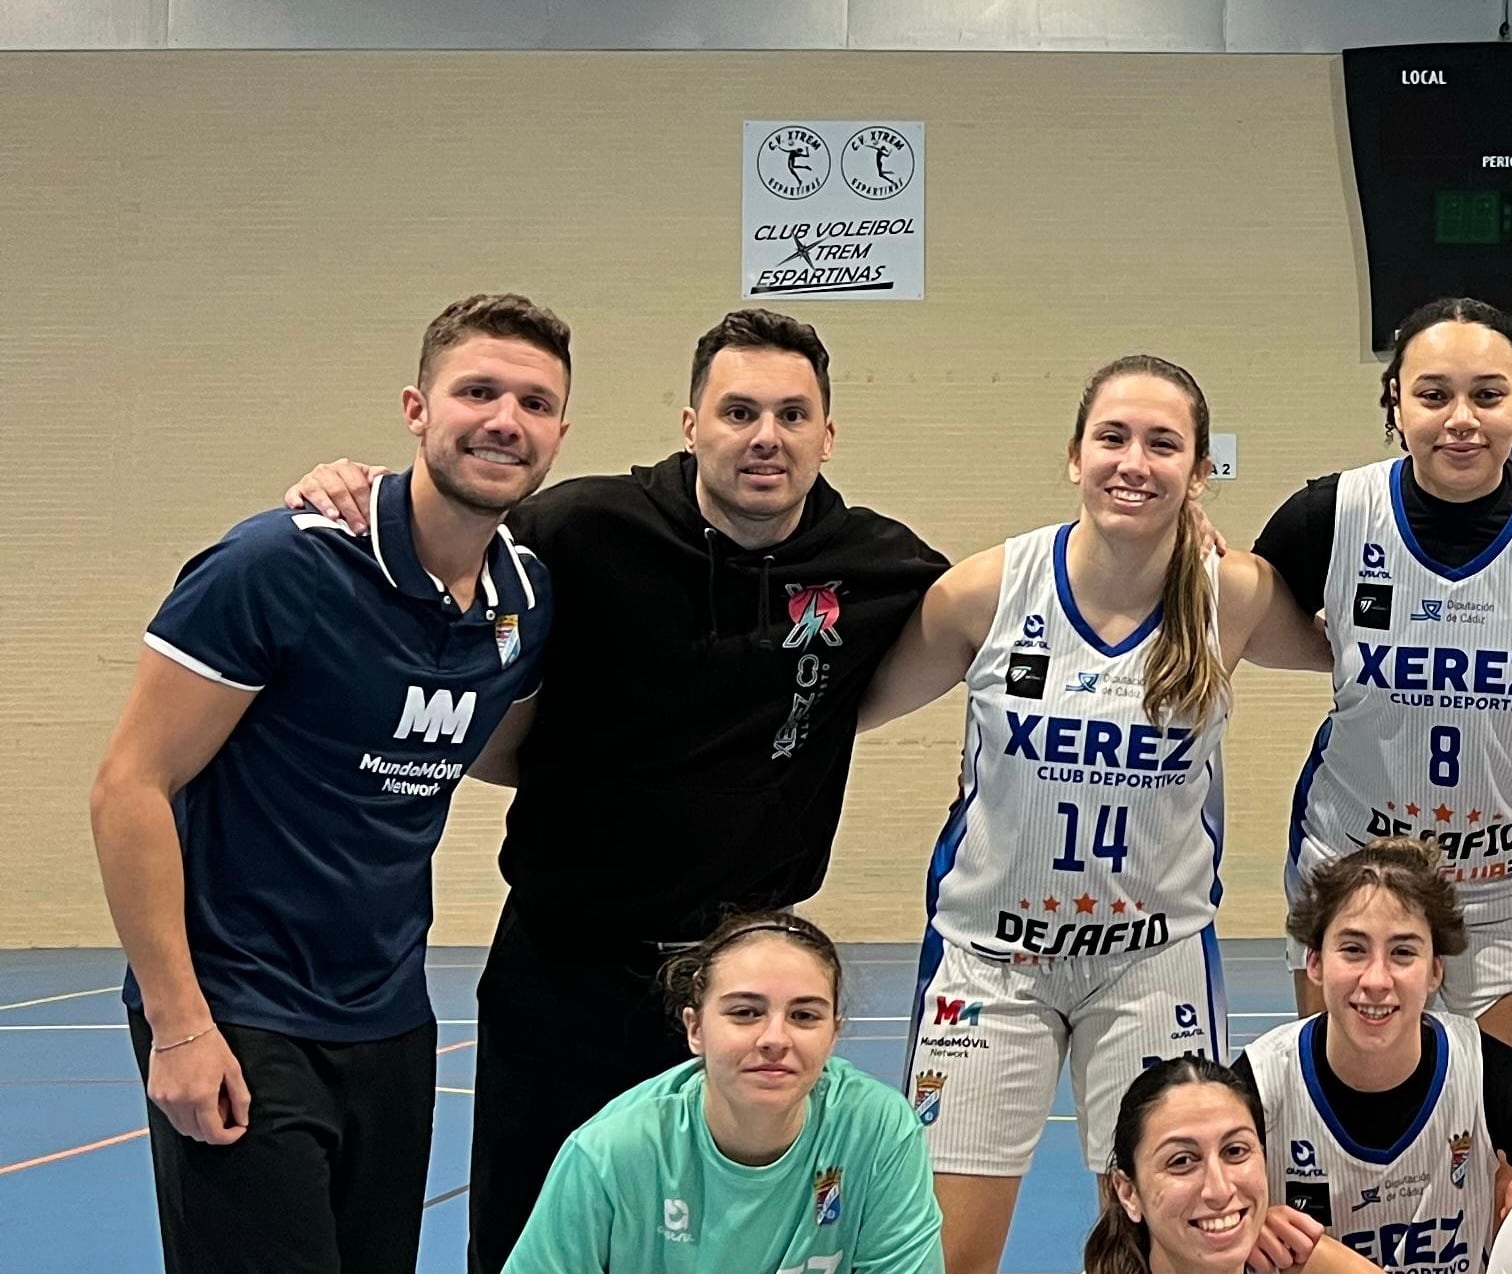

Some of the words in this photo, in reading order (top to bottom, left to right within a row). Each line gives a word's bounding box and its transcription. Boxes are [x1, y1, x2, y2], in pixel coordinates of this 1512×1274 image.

[1401, 69, 1447, 85] LOCAL
[787, 130, 823, 151] XTREM
[870, 130, 906, 151] XTREM
[768, 177, 822, 198] ESPARTINAS
[851, 177, 904, 198] ESPARTINAS
[754, 222, 811, 242] CLUB
[815, 218, 916, 239] VOLEIBOL
[756, 265, 886, 286] ESPARTINAS
[1222, 463, 1231, 475] 2
[1446, 599, 1495, 613] Diputación
[1446, 613, 1457, 623] de
[1460, 612, 1486, 625] Cádiz
[1102, 672, 1147, 686] Diputació
[1390, 692, 1434, 707] CLUB
[392, 685, 478, 744] MM
[1004, 711, 1197, 771] XEREZ
[1428, 724, 1461, 788] 8
[1037, 766, 1084, 783] CLUB
[1089, 770, 1186, 789] DEPORTIVO
[1053, 801, 1129, 873] 14
[995, 910, 1169, 960] DESAFIO
[930, 1048, 970, 1059] Network
[1341, 1209, 1468, 1268] EREZ
